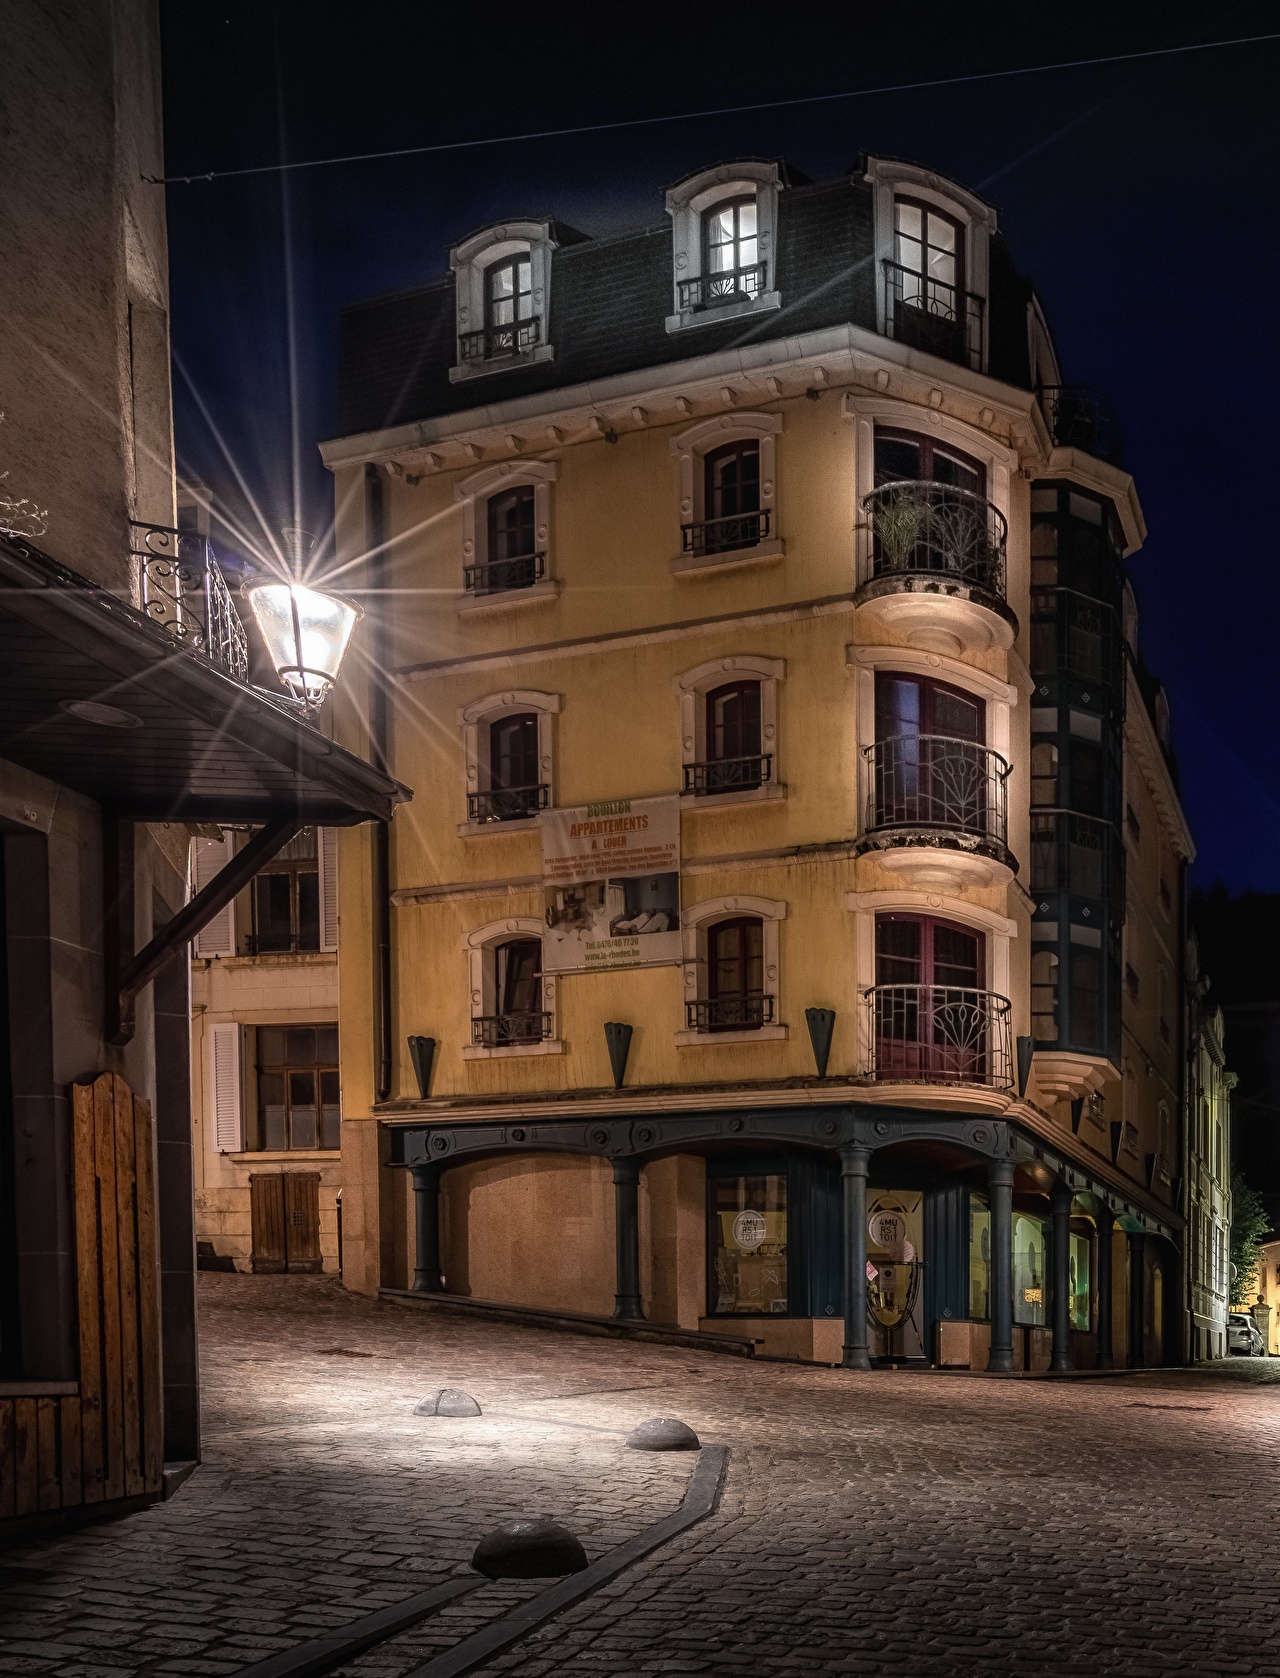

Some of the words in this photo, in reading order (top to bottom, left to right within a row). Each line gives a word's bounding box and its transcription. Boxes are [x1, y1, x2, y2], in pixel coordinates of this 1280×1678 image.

[588, 800, 631, 818] BOUILLON
[570, 815, 648, 837] APPARTEMENTS
[592, 840, 597, 850] A
[604, 836, 626, 848] LOUER
